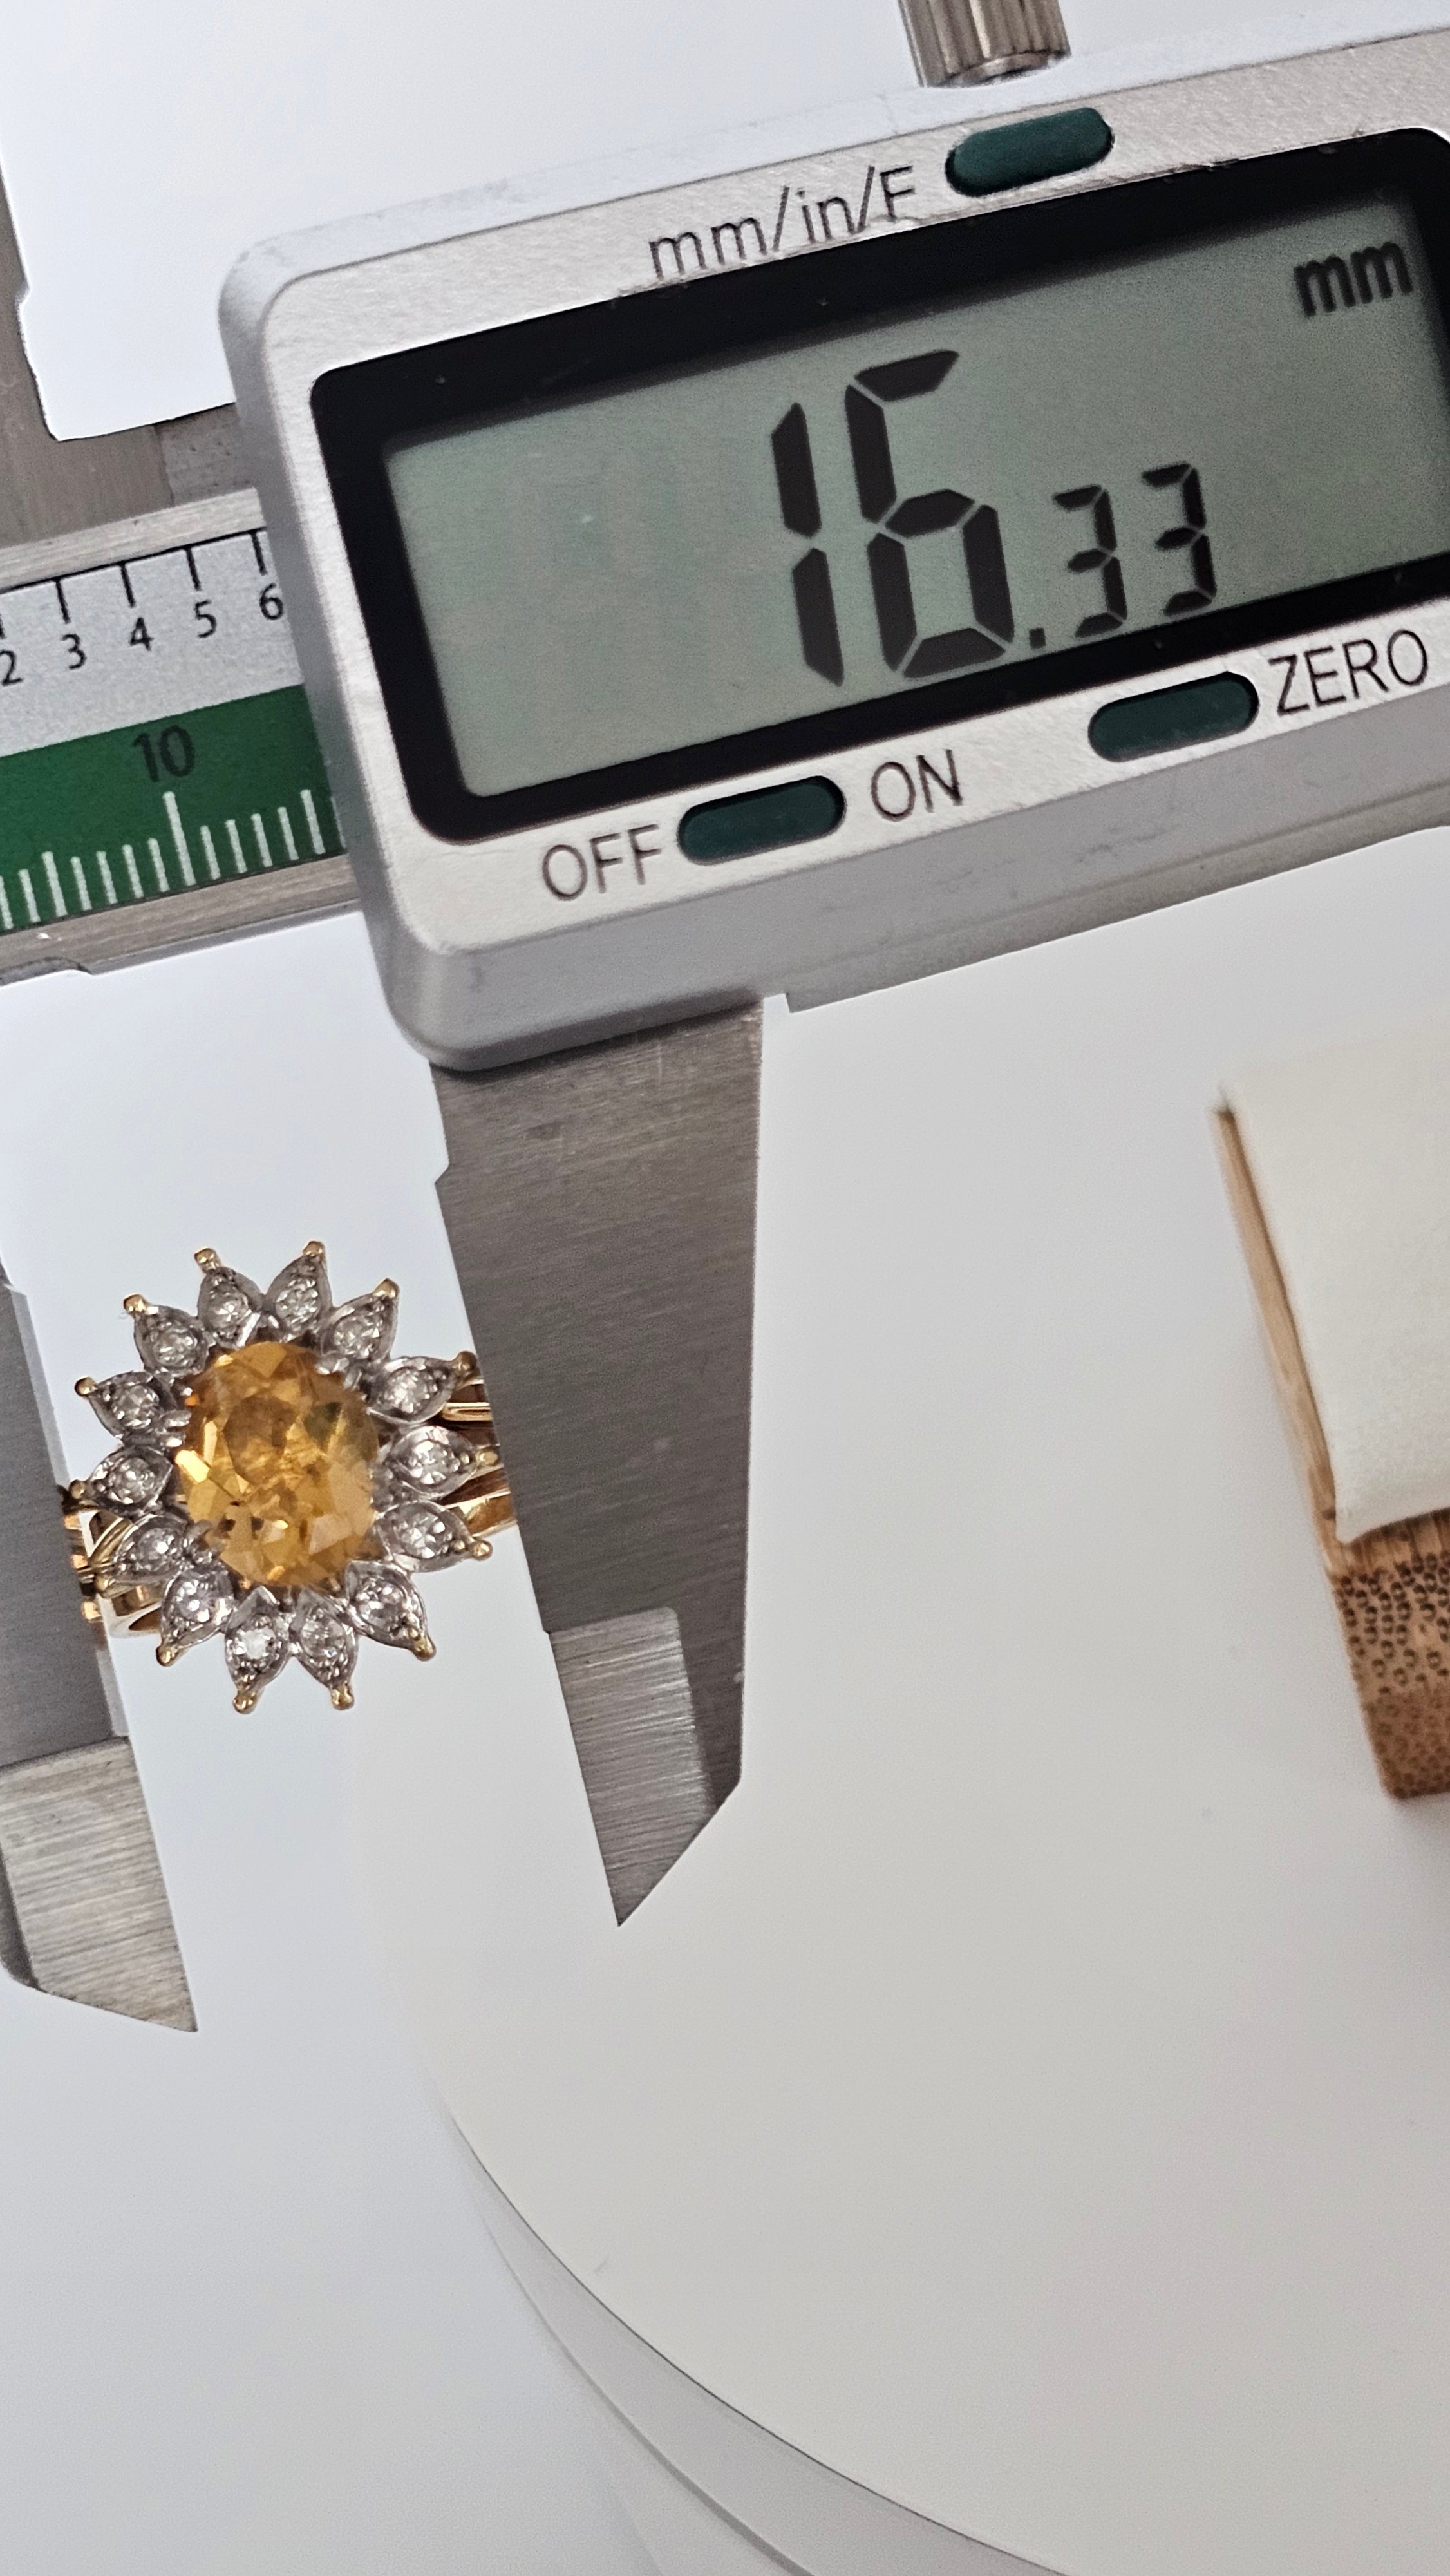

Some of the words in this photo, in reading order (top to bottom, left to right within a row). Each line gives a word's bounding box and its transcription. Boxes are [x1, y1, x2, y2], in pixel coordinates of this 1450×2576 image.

[648, 166, 916, 282] mm/in/F
[1294, 242, 1414, 317] mm
[771, 349, 1217, 687] 16.33
[0, 651, 23, 685] 2
[62, 634, 87, 670] 3
[129, 618, 154, 651] 4
[194, 600, 217, 638] 5
[259, 583, 284, 620] 6
[1268, 629, 1428, 716] ZERO
[131, 724, 195, 782] 10
[871, 750, 963, 822] ON
[541, 824, 661, 901] OFF
